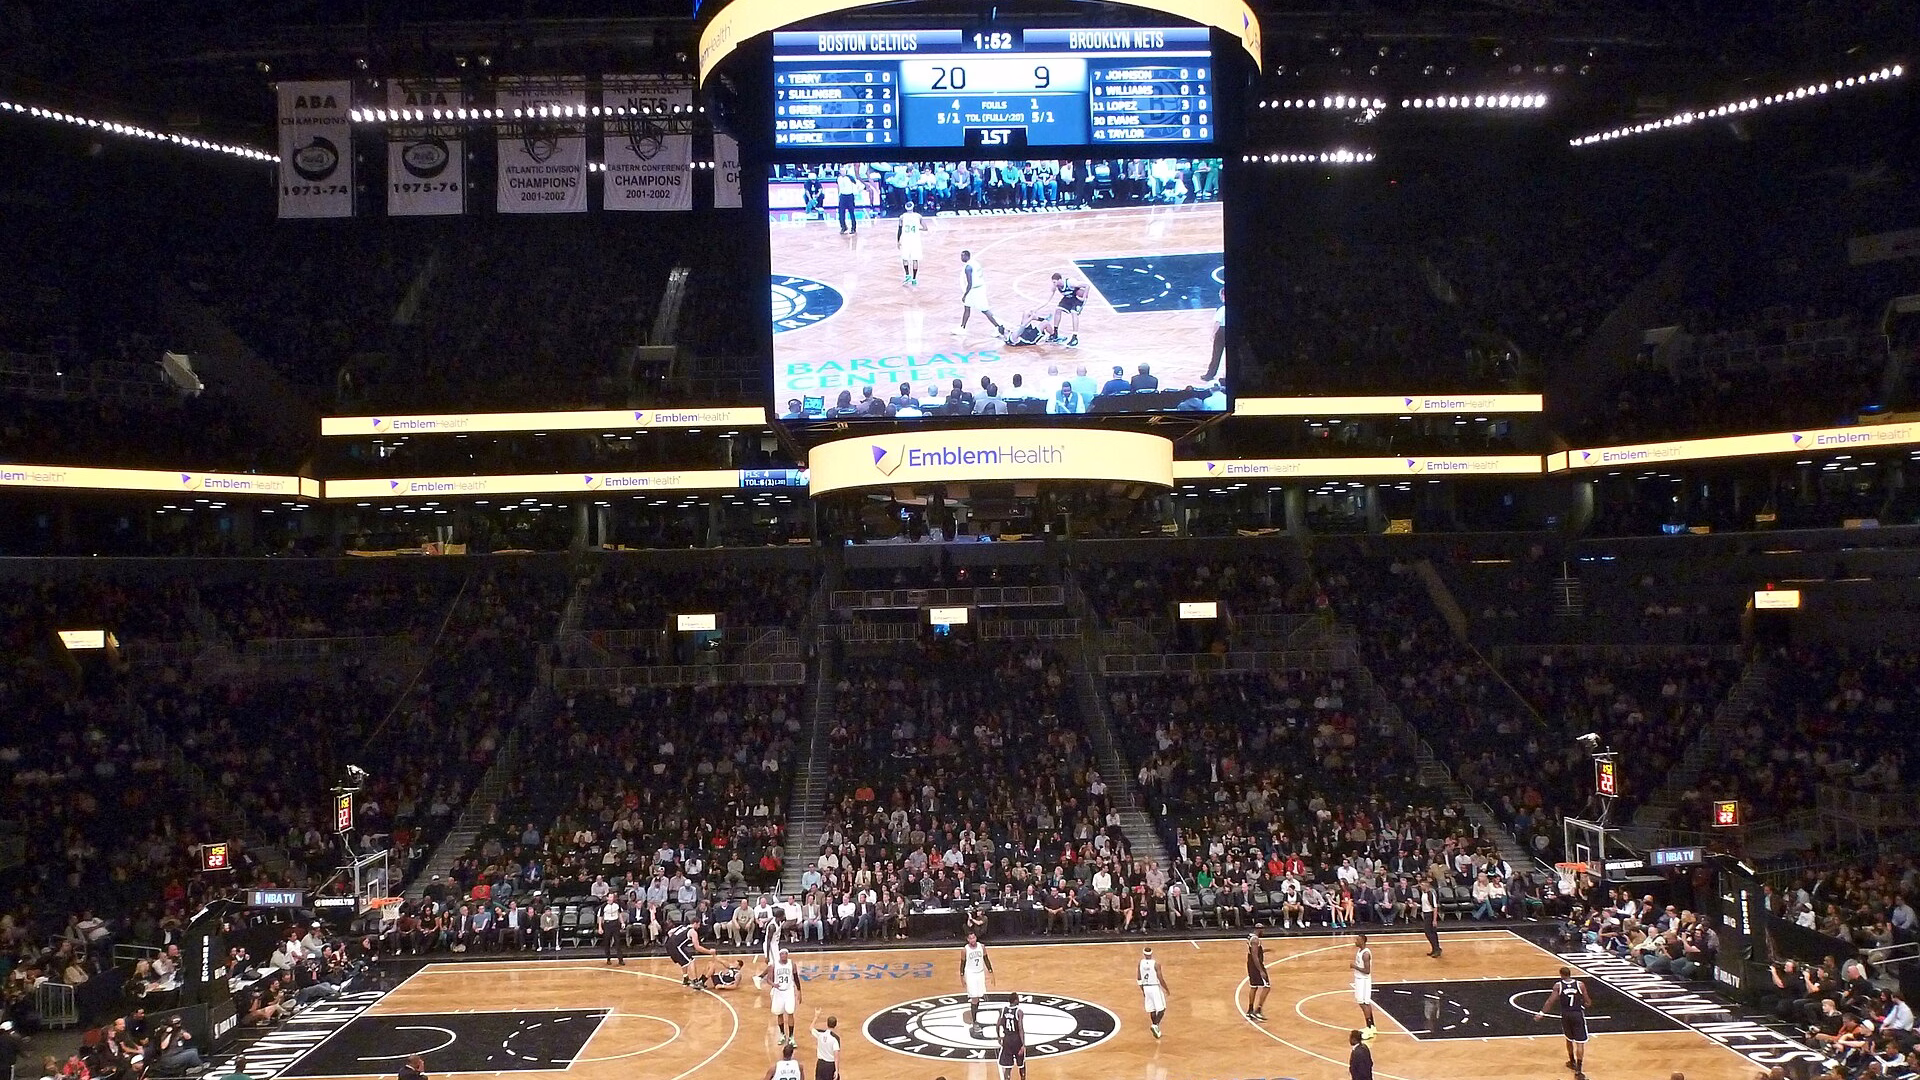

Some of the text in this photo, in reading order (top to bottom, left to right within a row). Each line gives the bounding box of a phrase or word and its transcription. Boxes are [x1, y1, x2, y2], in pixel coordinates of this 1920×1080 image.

[818, 34, 917, 51] BOSTON CELTICS
[973, 33, 1012, 49] 1:52
[1069, 31, 1164, 49] BROOKLYN NETS
[778, 72, 890, 84] 4 TERRY 0 0
[931, 67, 966, 89] 20
[1034, 66, 1050, 88] 9
[1094, 69, 1206, 80] 7 JOHNSON 0 0
[778, 88, 891, 100] 7 SULLINGER 2 2
[1106, 85, 1153, 96] WILLIAMS
[1180, 85, 1189, 95] 0
[1198, 84, 1206, 95] 1
[295, 95, 337, 109] ABA
[951, 98, 1038, 110] 4 FOULS 1
[1093, 99, 1207, 111] 11 LOPEZ 3 0
[789, 105, 822, 115] GREEN
[866, 104, 874, 114] 0
[883, 104, 891, 114] 0
[281, 117, 347, 126] CHAMPIONS
[937, 112, 961, 124] 5/1
[965, 113, 981, 122] TOL
[1031, 111, 1055, 123] 5/1
[1107, 115, 1140, 125] EVANS
[1181, 114, 1190, 125] 0
[1199, 114, 1207, 125] 0
[789, 120, 816, 130] BASS
[866, 118, 874, 129] 2
[883, 118, 892, 129] 0
[789, 133, 823, 143] PIERCE
[883, 132, 892, 142] 1
[981, 129, 1011, 144] 1ST
[1094, 128, 1208, 139] 41 TAYLOR 0 0
[506, 165, 580, 174] ATLANTIC DIVISION
[607, 164, 690, 172] EASTERN CONFERENCE
[509, 177, 577, 189] CHAMPIONS
[615, 175, 681, 187] CHAMPIONS
[283, 185, 348, 196] 1973-74
[393, 182, 459, 193] 1975-76
[521, 191, 565, 201] 2001-2002
[626, 190, 670, 199] 2001-2002
[904, 225, 916, 234] 34
[787, 350, 1001, 375] BARCLAYS
[787, 367, 966, 390] CENTER
[1424, 399, 1495, 409] EmblemHealth
[393, 418, 468, 429] EmblemHealth
[655, 412, 730, 423] EmblemHealth
[1817, 428, 1912, 445] EmblemHealth
[909, 445, 1063, 467] EmblemHealth
[1603, 447, 1682, 461] EmblemHealth
[1227, 463, 1300, 474] EmblemHealth
[1427, 461, 1498, 471] EmblemHealth
[204, 478, 284, 491] EmblemHealth
[411, 481, 486, 492] EmblemHealth
[605, 476, 680, 487] EmblemHealth
[1600, 773, 1613, 793] 22
[1719, 812, 1733, 823] 22
[208, 855, 222, 866] 22
[1666, 851, 1694, 862] NBA TV
[264, 893, 295, 904] NBA TV
[974, 959, 980, 967] 7
[778, 976, 789, 984] 34
[799, 971, 933, 982] BARCLA
[1567, 994, 1575, 1007] 7
[286, 991, 386, 1024] NETS
[1557, 951, 1826, 1063] BROOKLYN NETS
[1005, 1019, 1016, 1031] 41
[883, 1028, 1107, 1060] BROKLYN
